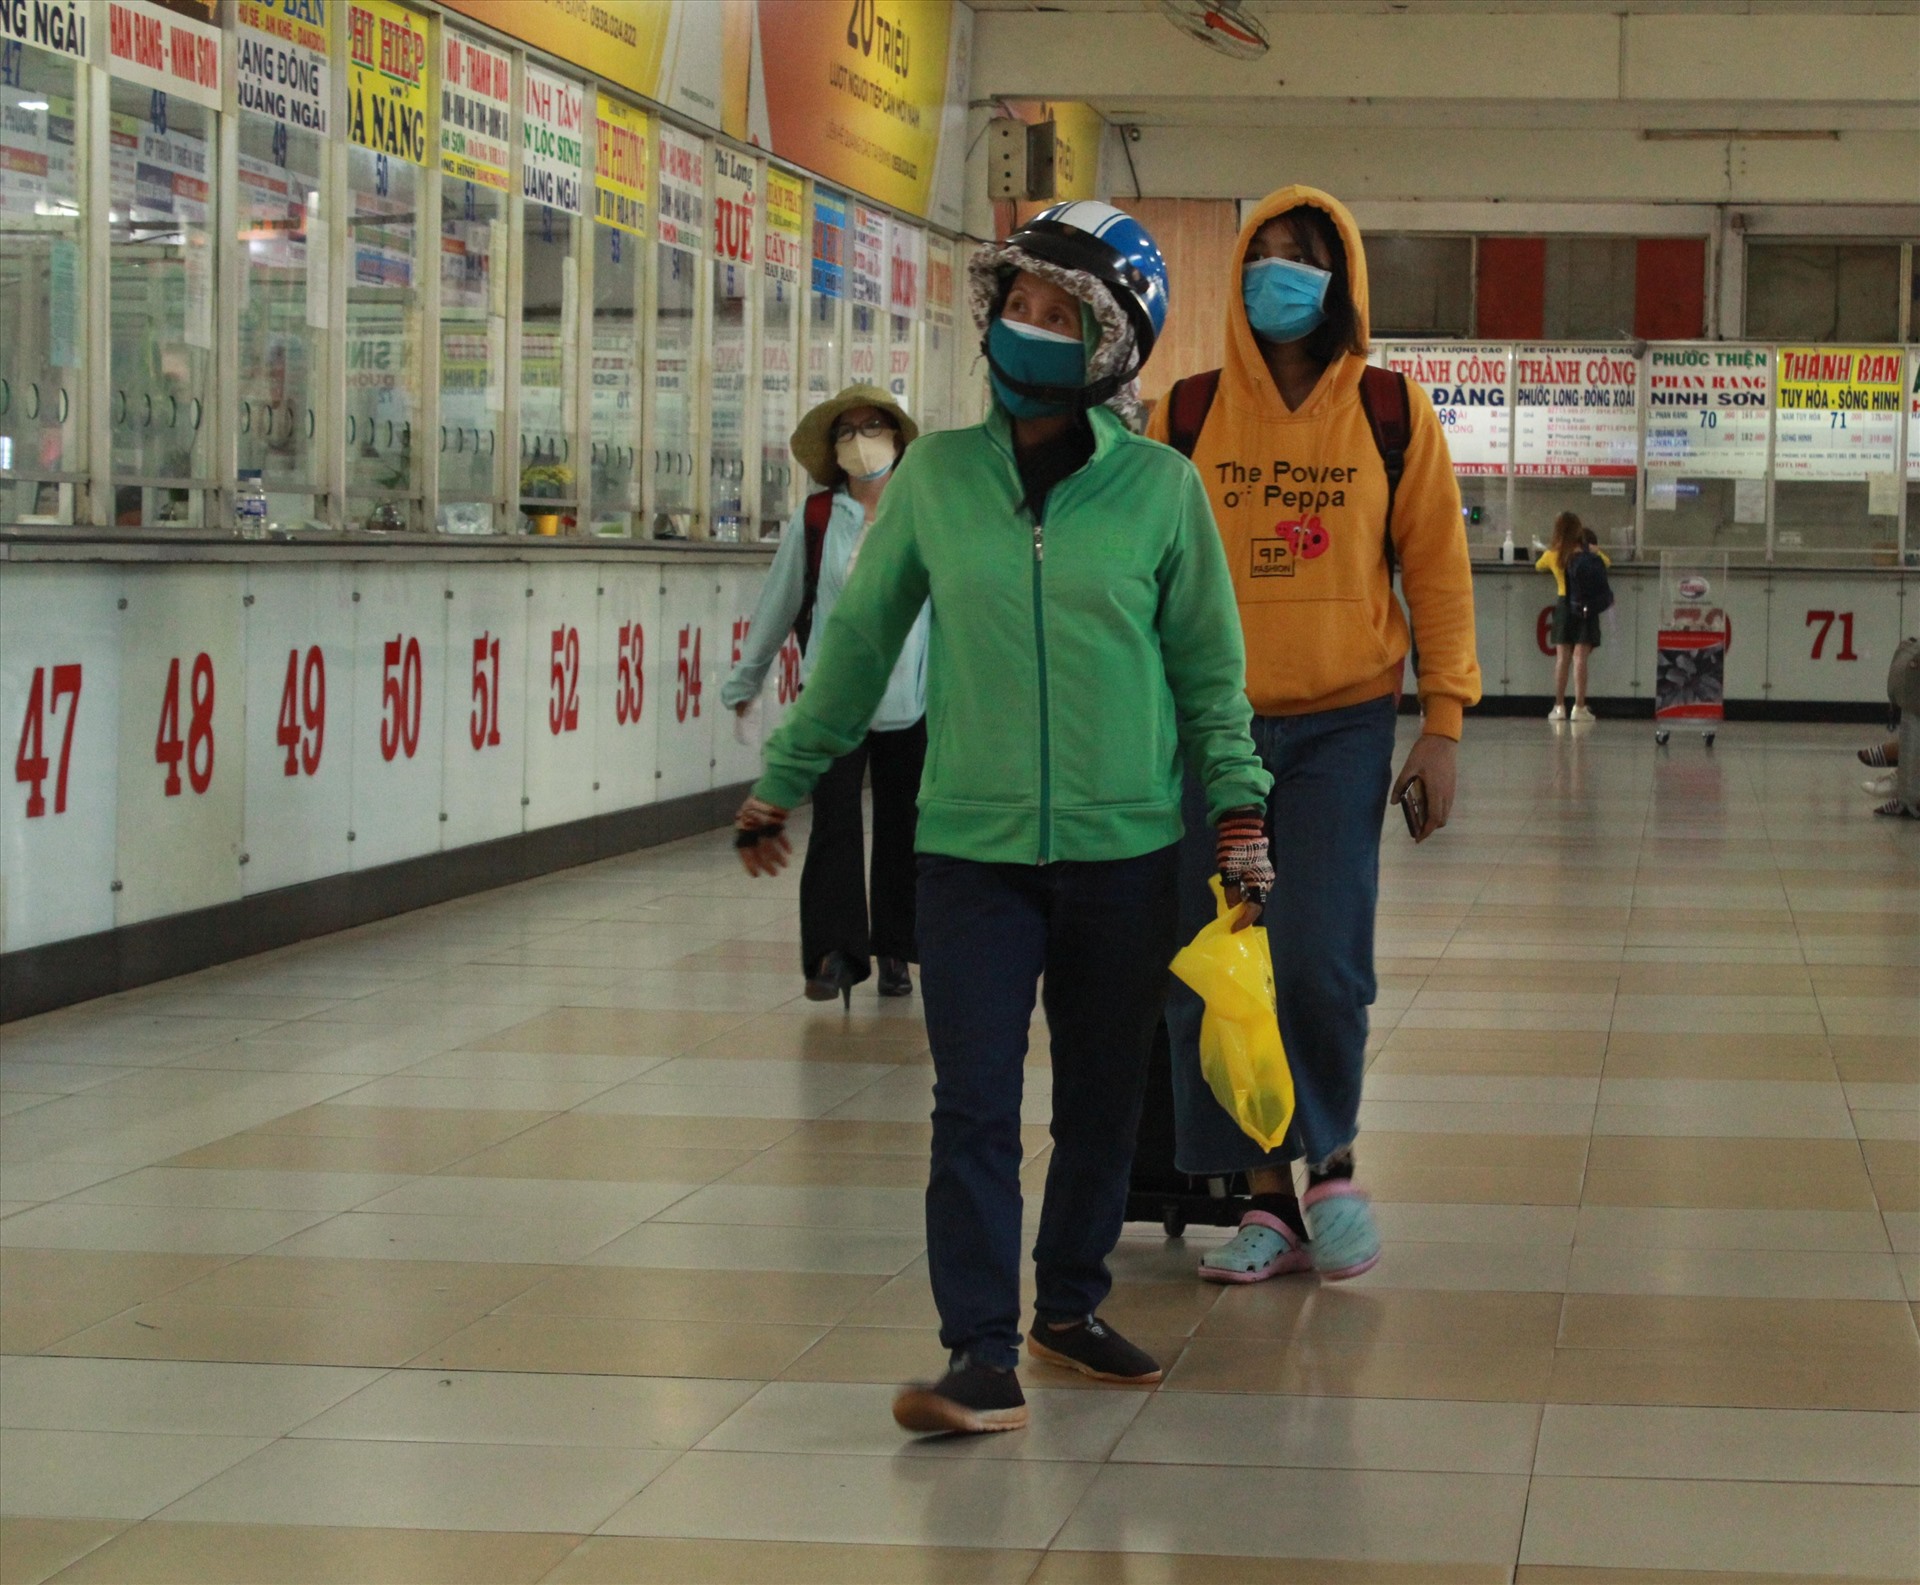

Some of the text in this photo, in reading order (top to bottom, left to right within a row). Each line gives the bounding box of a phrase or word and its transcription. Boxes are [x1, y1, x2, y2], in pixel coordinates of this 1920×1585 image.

[34, 0, 85, 57] NGÃI
[134, 11, 163, 71] RANG
[877, 16, 910, 83] TRIỆU
[277, 47, 318, 96] ĐÔNG
[290, 100, 325, 132] NGÃI
[556, 83, 582, 134] TÂM
[534, 123, 555, 161] LỘC
[557, 135, 582, 168] SINH
[376, 153, 389, 197] 50
[731, 154, 753, 191] Long
[555, 171, 581, 212] NGÃI
[1410, 345, 1437, 353] CHẤT
[1442, 346, 1478, 355] LƯỢNG
[1539, 346, 1567, 354] CHẤT
[1571, 347, 1607, 355] LƯỢNG
[1652, 349, 1767, 370] PHƯỚC THIỆN
[1784, 348, 1852, 382] THÀNH
[1388, 354, 1507, 385] THÀNH CÔNG
[1518, 355, 1637, 385] THÀNH CÔNG
[1651, 376, 1766, 389] PHAN RANG
[1432, 384, 1505, 406] ĐĂNG
[1518, 384, 1635, 407] PHƯỚC LONG ĐỒNG XOÀI
[1651, 391, 1766, 406] NINH SƠN
[1781, 388, 1803, 408] TUY
[1805, 383, 1829, 409] HÒA
[1838, 385, 1869, 410] SÔNG
[1872, 390, 1900, 411] HINH
[1438, 407, 1457, 426] 68
[1699, 410, 1717, 429] 70
[1830, 411, 1847, 429] 71
[1215, 460, 1358, 484] The Power
[1224, 485, 1345, 513] o Peppa
[1253, 564, 1291, 573] FASHION
[1805, 609, 1859, 661] 71
[549, 623, 580, 736] 52
[616, 619, 644, 726] 53
[676, 623, 702, 723] 54
[380, 633, 422, 762] 50
[470, 630, 500, 751] 51
[154, 652, 215, 797] 48
[276, 644, 327, 776] 49
[15, 663, 82, 818] 47
